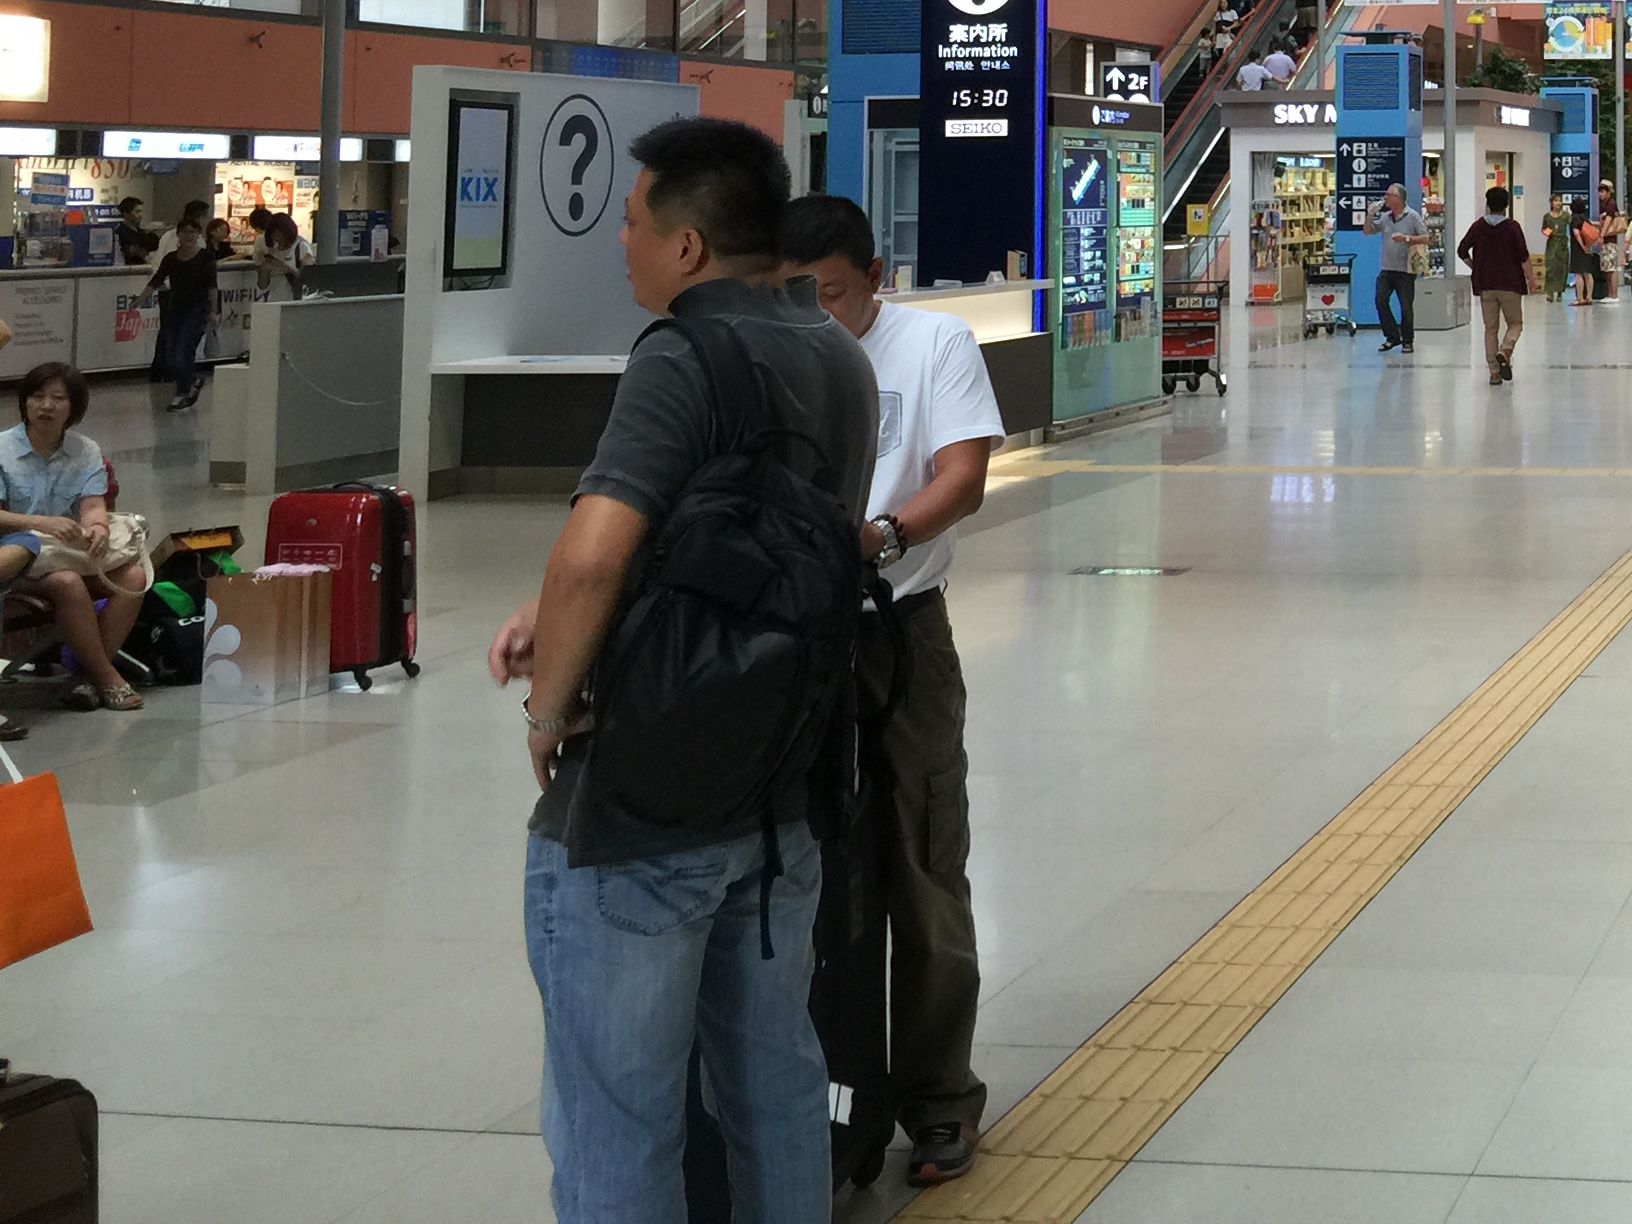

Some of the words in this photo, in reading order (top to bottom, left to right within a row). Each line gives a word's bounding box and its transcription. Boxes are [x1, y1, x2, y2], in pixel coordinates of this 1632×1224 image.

[948, 22, 1008, 43] 案内所
[938, 43, 1019, 58] Information
[1127, 72, 1149, 91] 2F
[952, 89, 1009, 107] 15:30
[1274, 105, 1320, 124] SKY
[950, 122, 1003, 135] SEIKO
[460, 176, 499, 202] KIX
